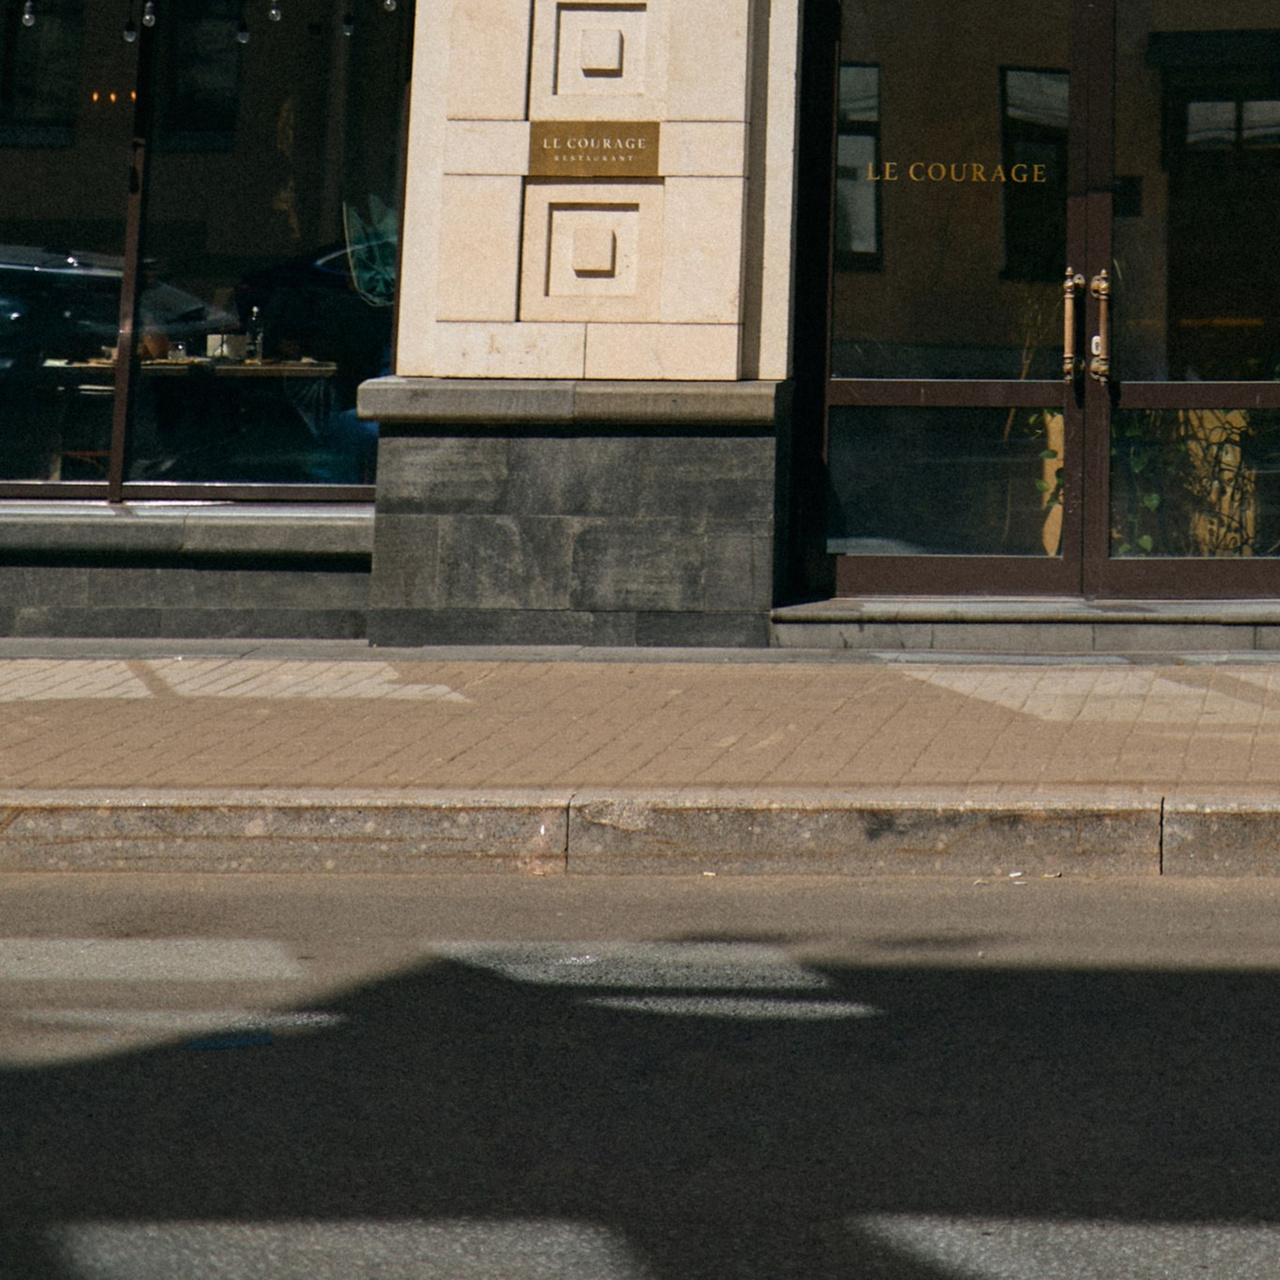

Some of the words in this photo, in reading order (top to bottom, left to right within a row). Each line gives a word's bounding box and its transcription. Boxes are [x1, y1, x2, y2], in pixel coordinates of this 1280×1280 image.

[543, 138, 561, 149] LE
[566, 138, 646, 149] COURAGE
[866, 162, 898, 181] LE
[908, 162, 1047, 183] COURAGE
